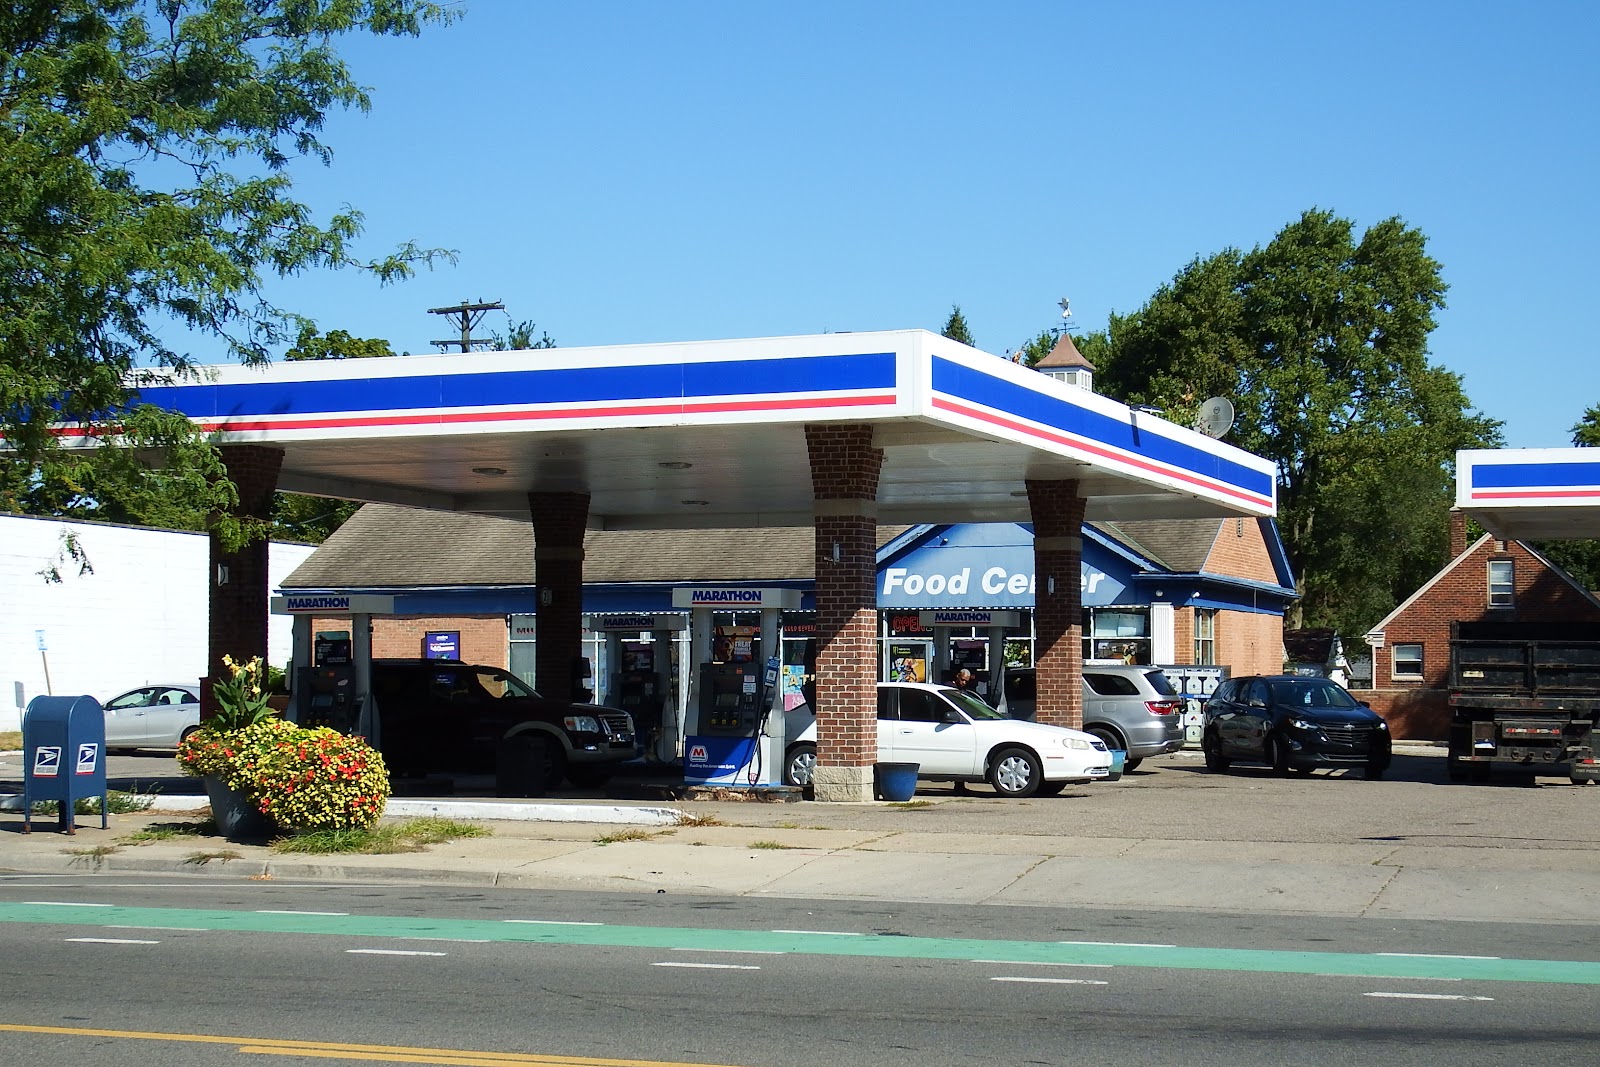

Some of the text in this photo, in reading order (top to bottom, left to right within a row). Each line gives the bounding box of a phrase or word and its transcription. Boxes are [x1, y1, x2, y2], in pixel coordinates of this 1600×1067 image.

[883, 566, 1105, 595] Food Cer
[692, 590, 762, 601] MARATHON
[287, 597, 349, 608] MARATHON
[603, 617, 655, 626] MARATHON
[934, 612, 991, 621] MARATHON
